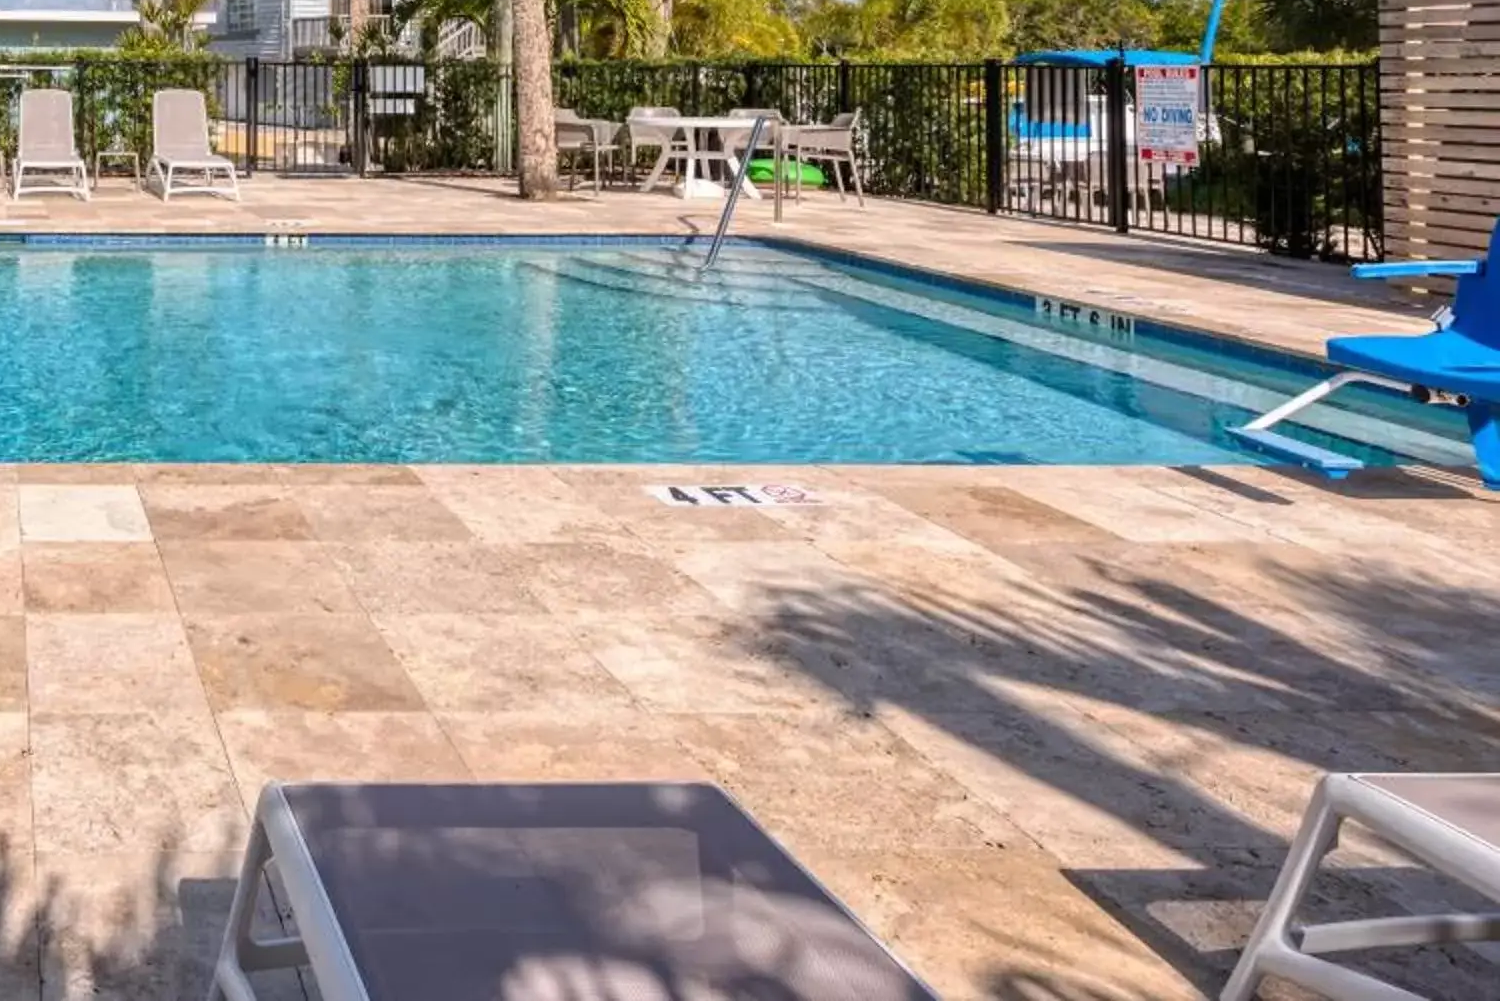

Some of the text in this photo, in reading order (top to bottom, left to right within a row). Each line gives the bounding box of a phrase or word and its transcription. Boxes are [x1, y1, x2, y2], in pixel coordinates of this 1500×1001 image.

[1143, 68, 1161, 78] POOL
[1143, 105, 1193, 123] NO DIVING
[288, 234, 305, 244] FT
[1060, 303, 1081, 320] FT
[1111, 315, 1130, 332] IN
[667, 486, 763, 505] 4 FT
